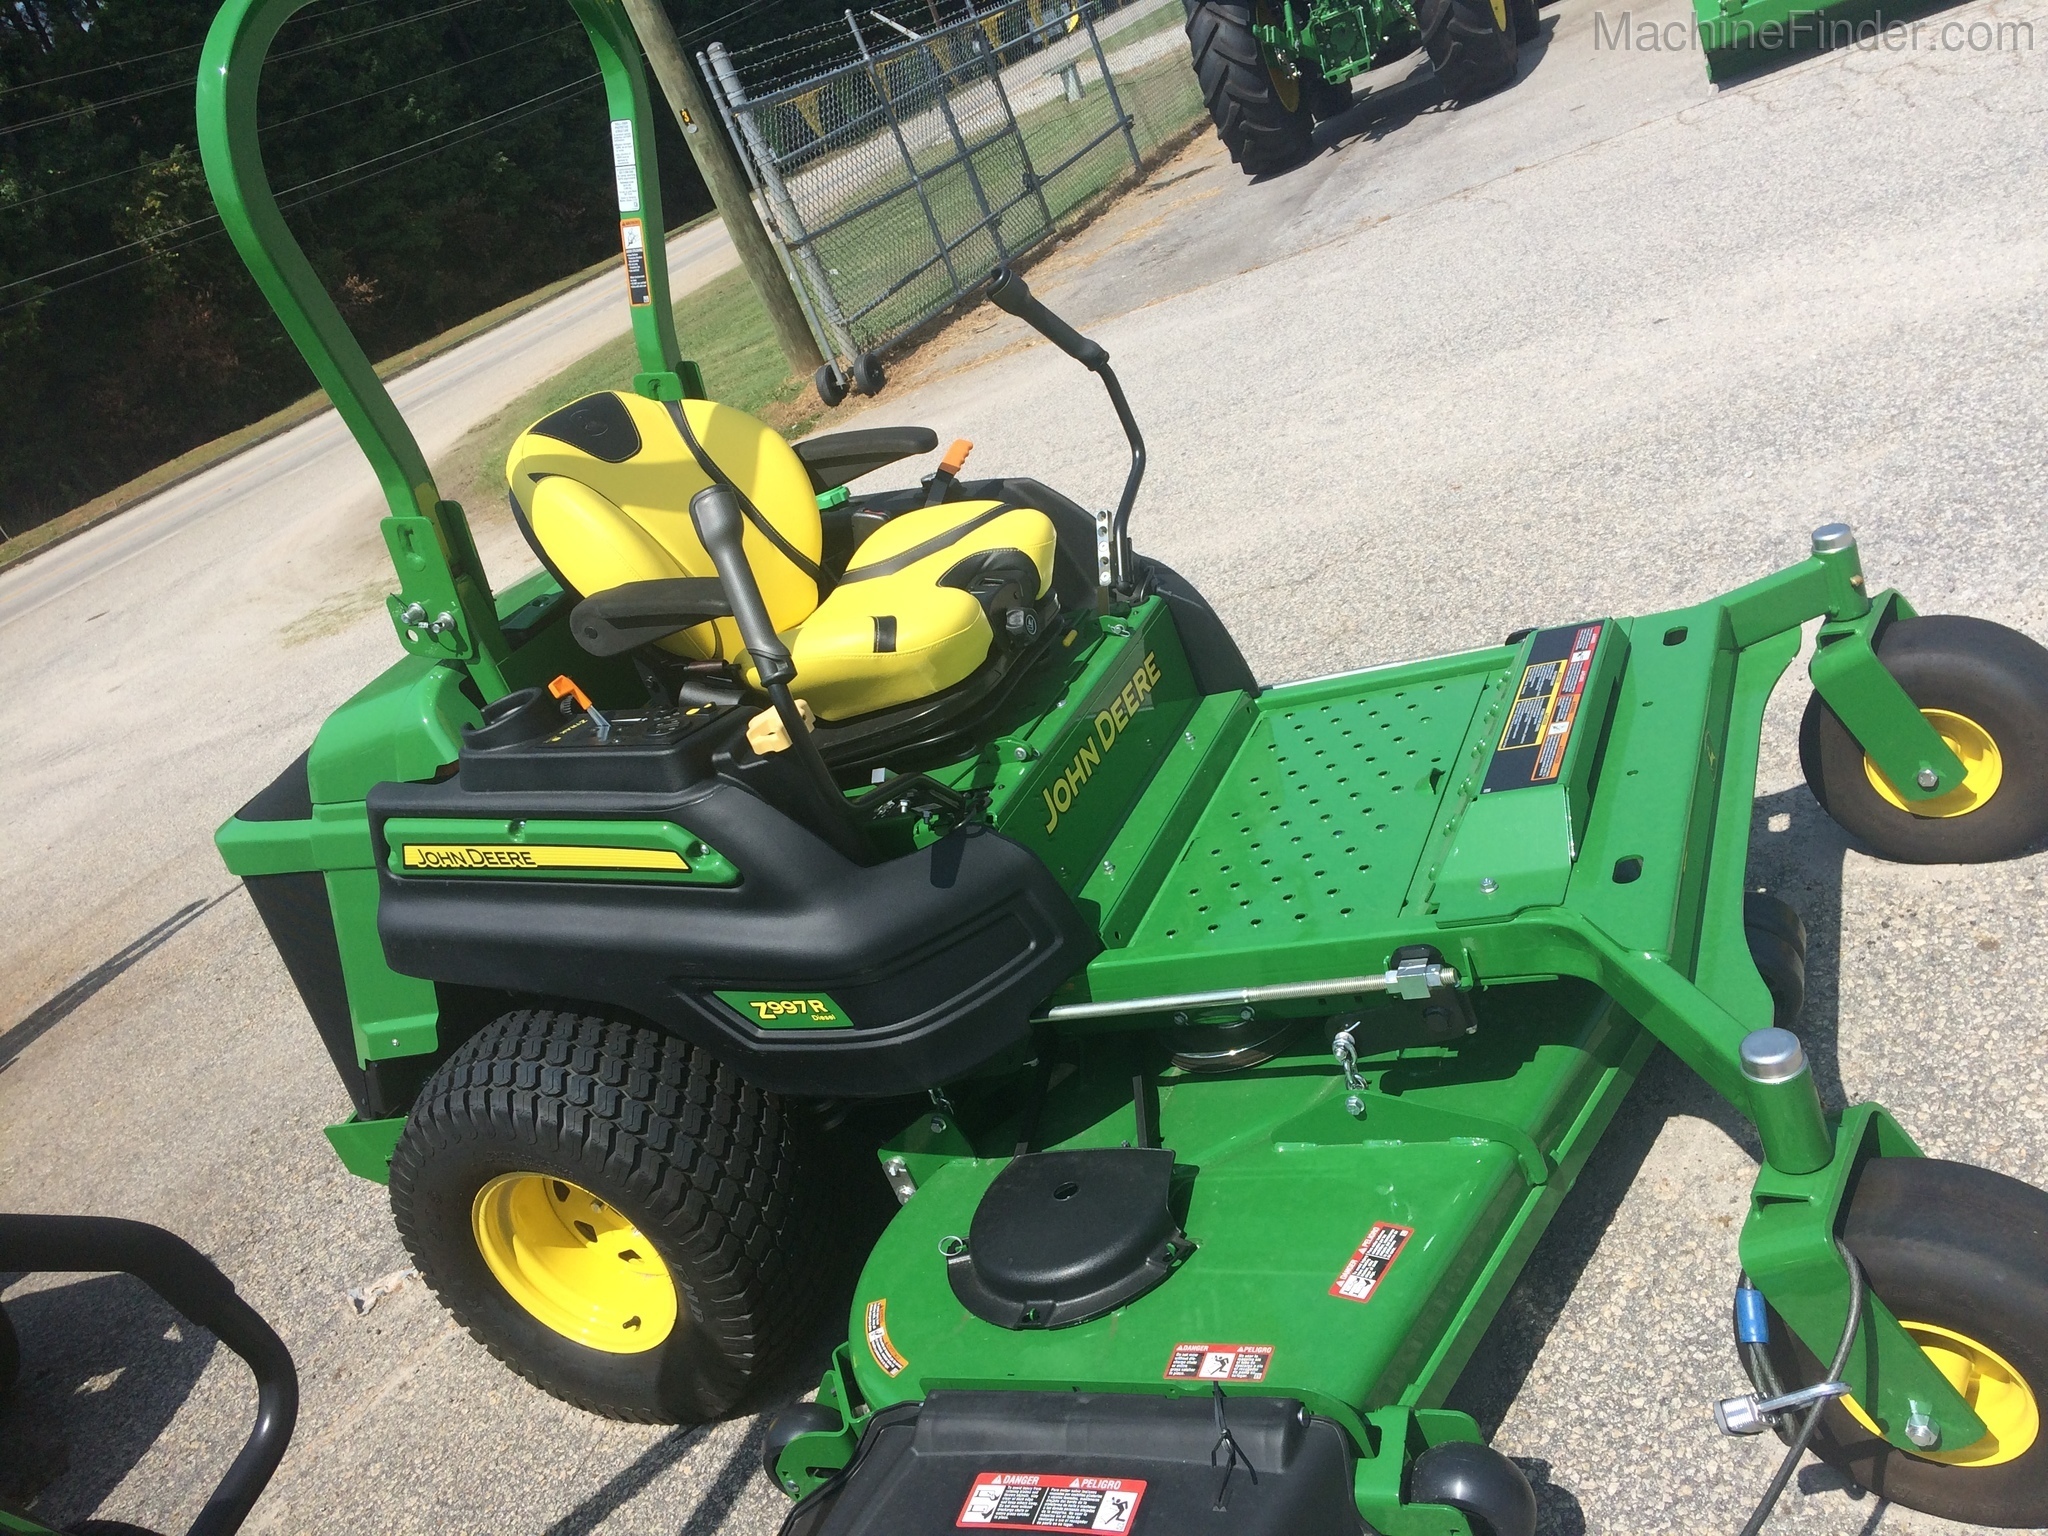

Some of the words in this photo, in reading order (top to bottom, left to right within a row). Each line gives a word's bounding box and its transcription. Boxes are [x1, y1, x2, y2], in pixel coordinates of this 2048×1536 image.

[1042, 736, 1101, 834] JOHN
[1094, 651, 1162, 752] DEERE
[417, 848, 467, 865] JOHN
[466, 848, 537, 866] DEERE
[1003, 1475, 1040, 1485] DANGER
[1080, 1478, 1121, 1490] PELIGRO
